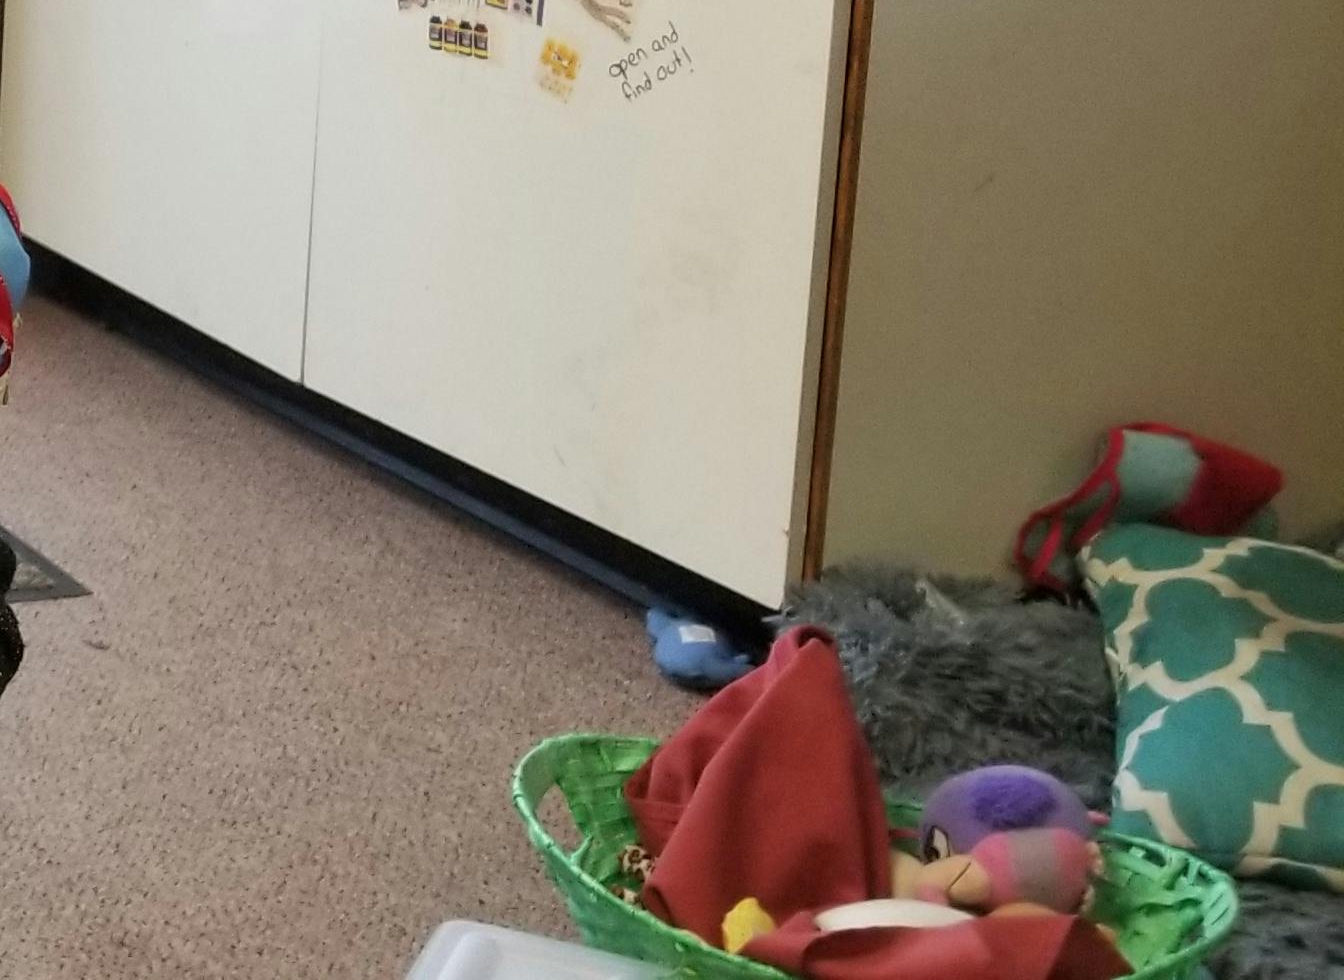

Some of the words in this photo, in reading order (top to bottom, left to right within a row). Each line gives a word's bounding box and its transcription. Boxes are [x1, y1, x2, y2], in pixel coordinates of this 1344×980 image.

[652, 20, 678, 52] and
[621, 71, 652, 102] find
[657, 46, 694, 81] out!
